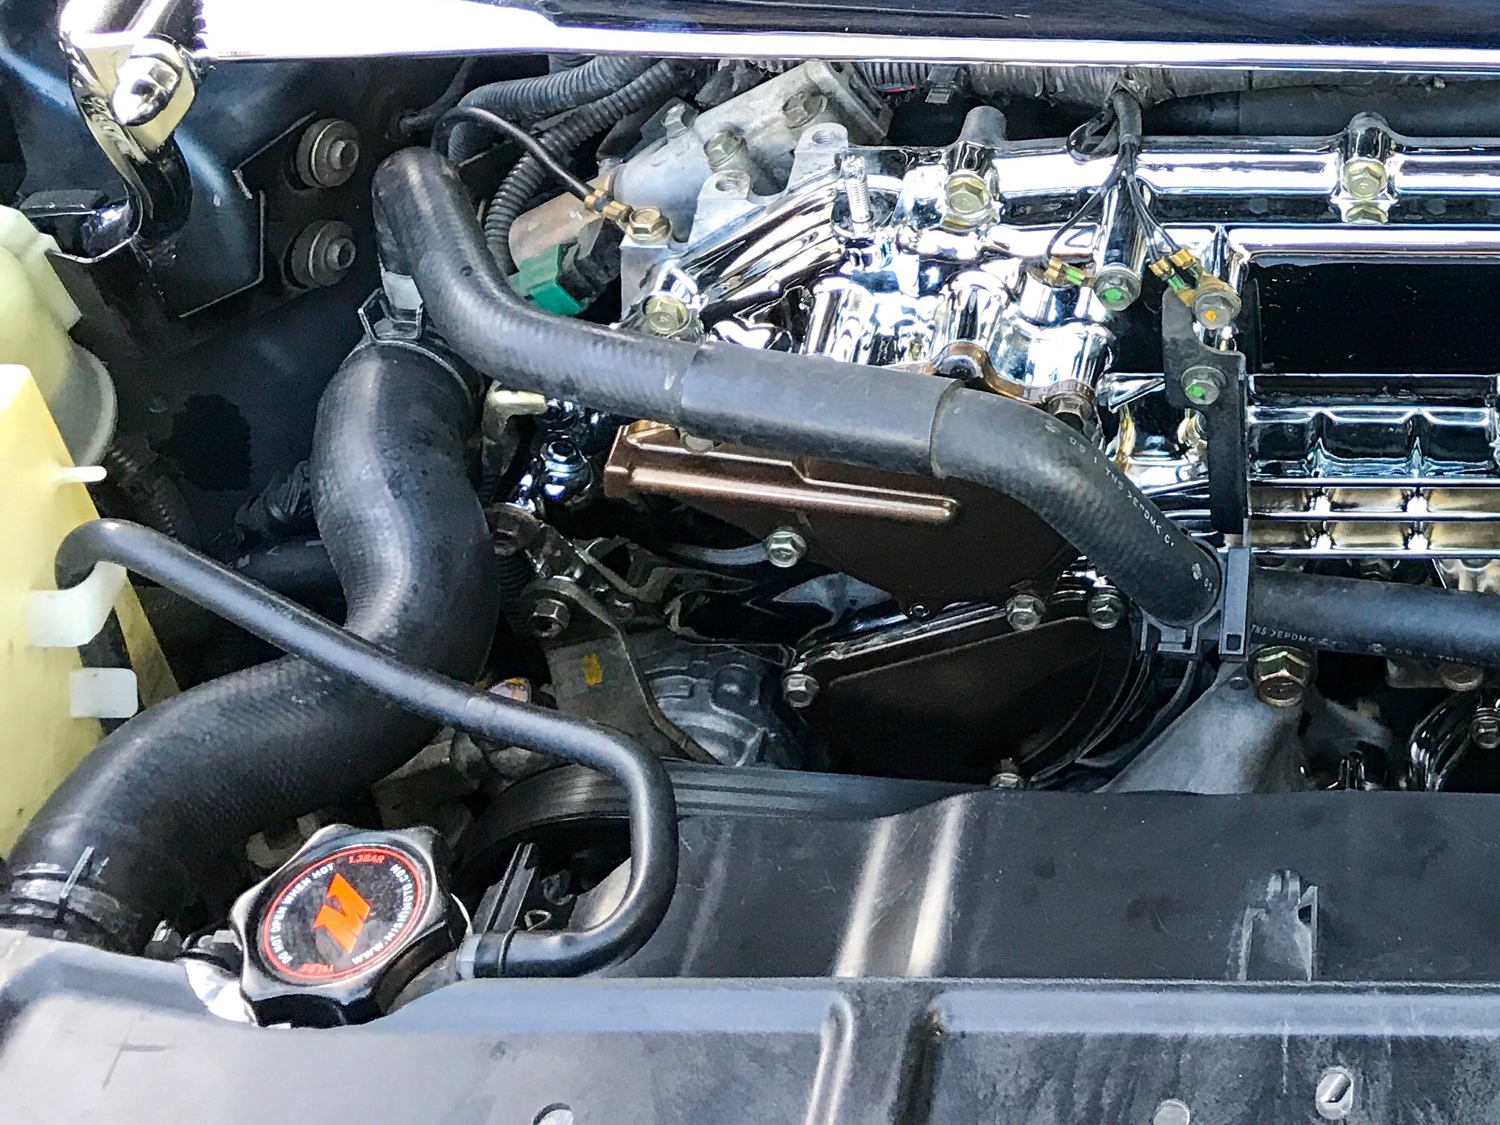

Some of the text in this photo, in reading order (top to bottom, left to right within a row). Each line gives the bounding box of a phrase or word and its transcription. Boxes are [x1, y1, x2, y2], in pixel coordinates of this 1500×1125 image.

[270, 862, 335, 965] DO NOT OPEN WHEN HOT
